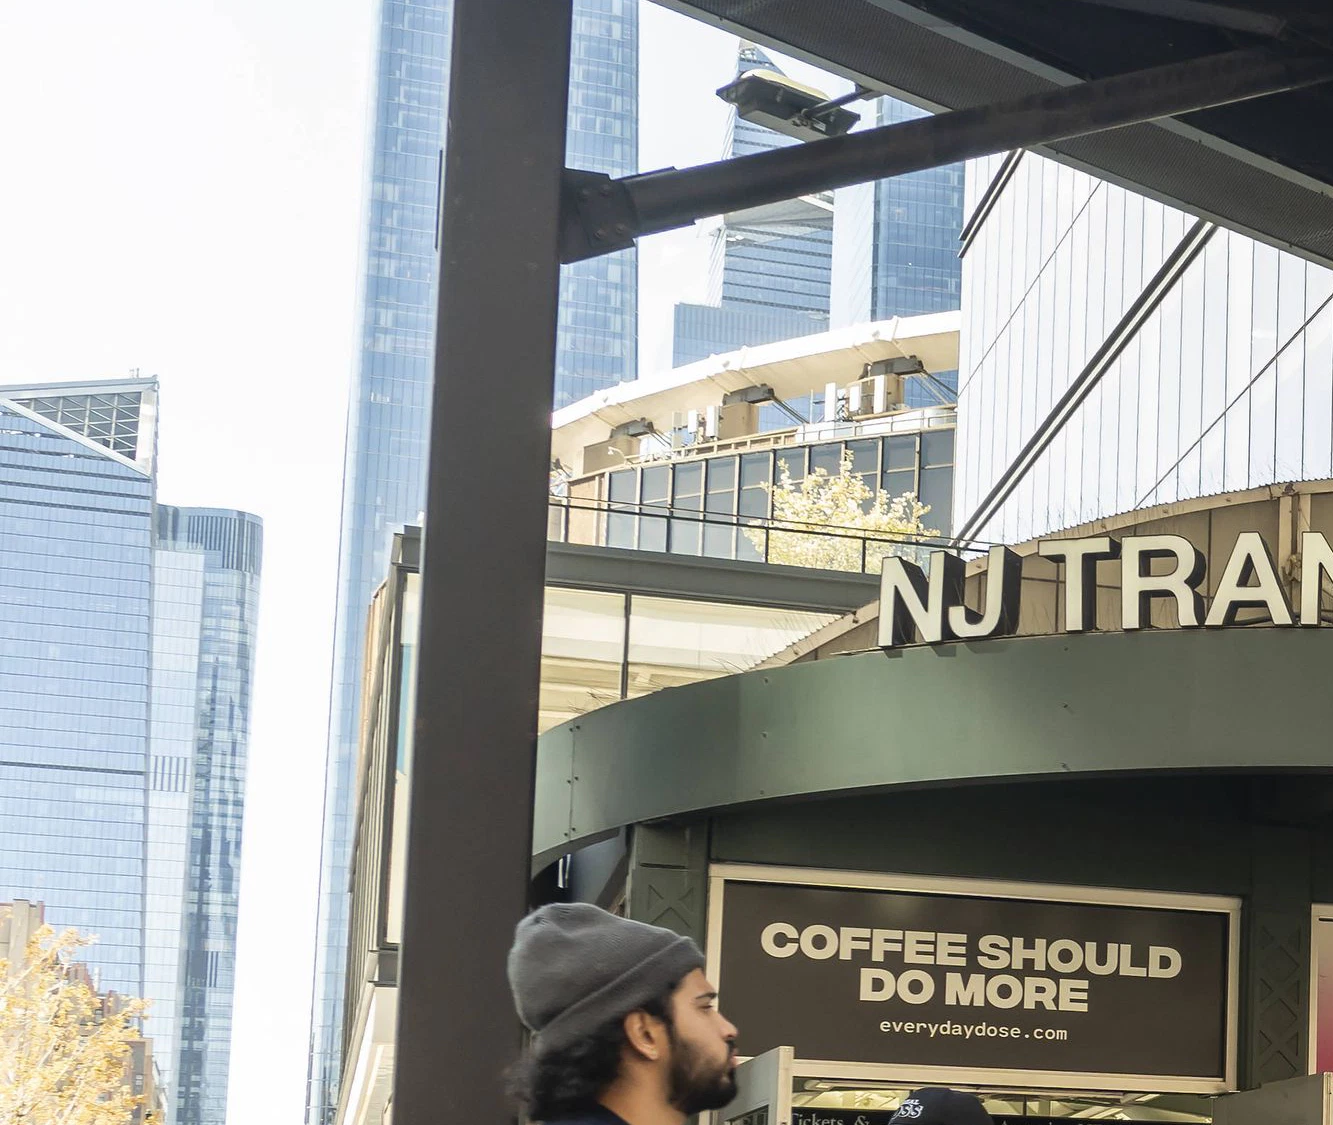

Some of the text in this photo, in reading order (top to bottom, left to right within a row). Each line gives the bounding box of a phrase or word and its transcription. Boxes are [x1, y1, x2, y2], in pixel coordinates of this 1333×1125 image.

[878, 545, 1010, 648] NJ
[760, 922, 1183, 979] COFFEE SHOULD
[859, 967, 1090, 1012] DO MORE
[879, 1018, 1069, 1041] everydaydose.com
